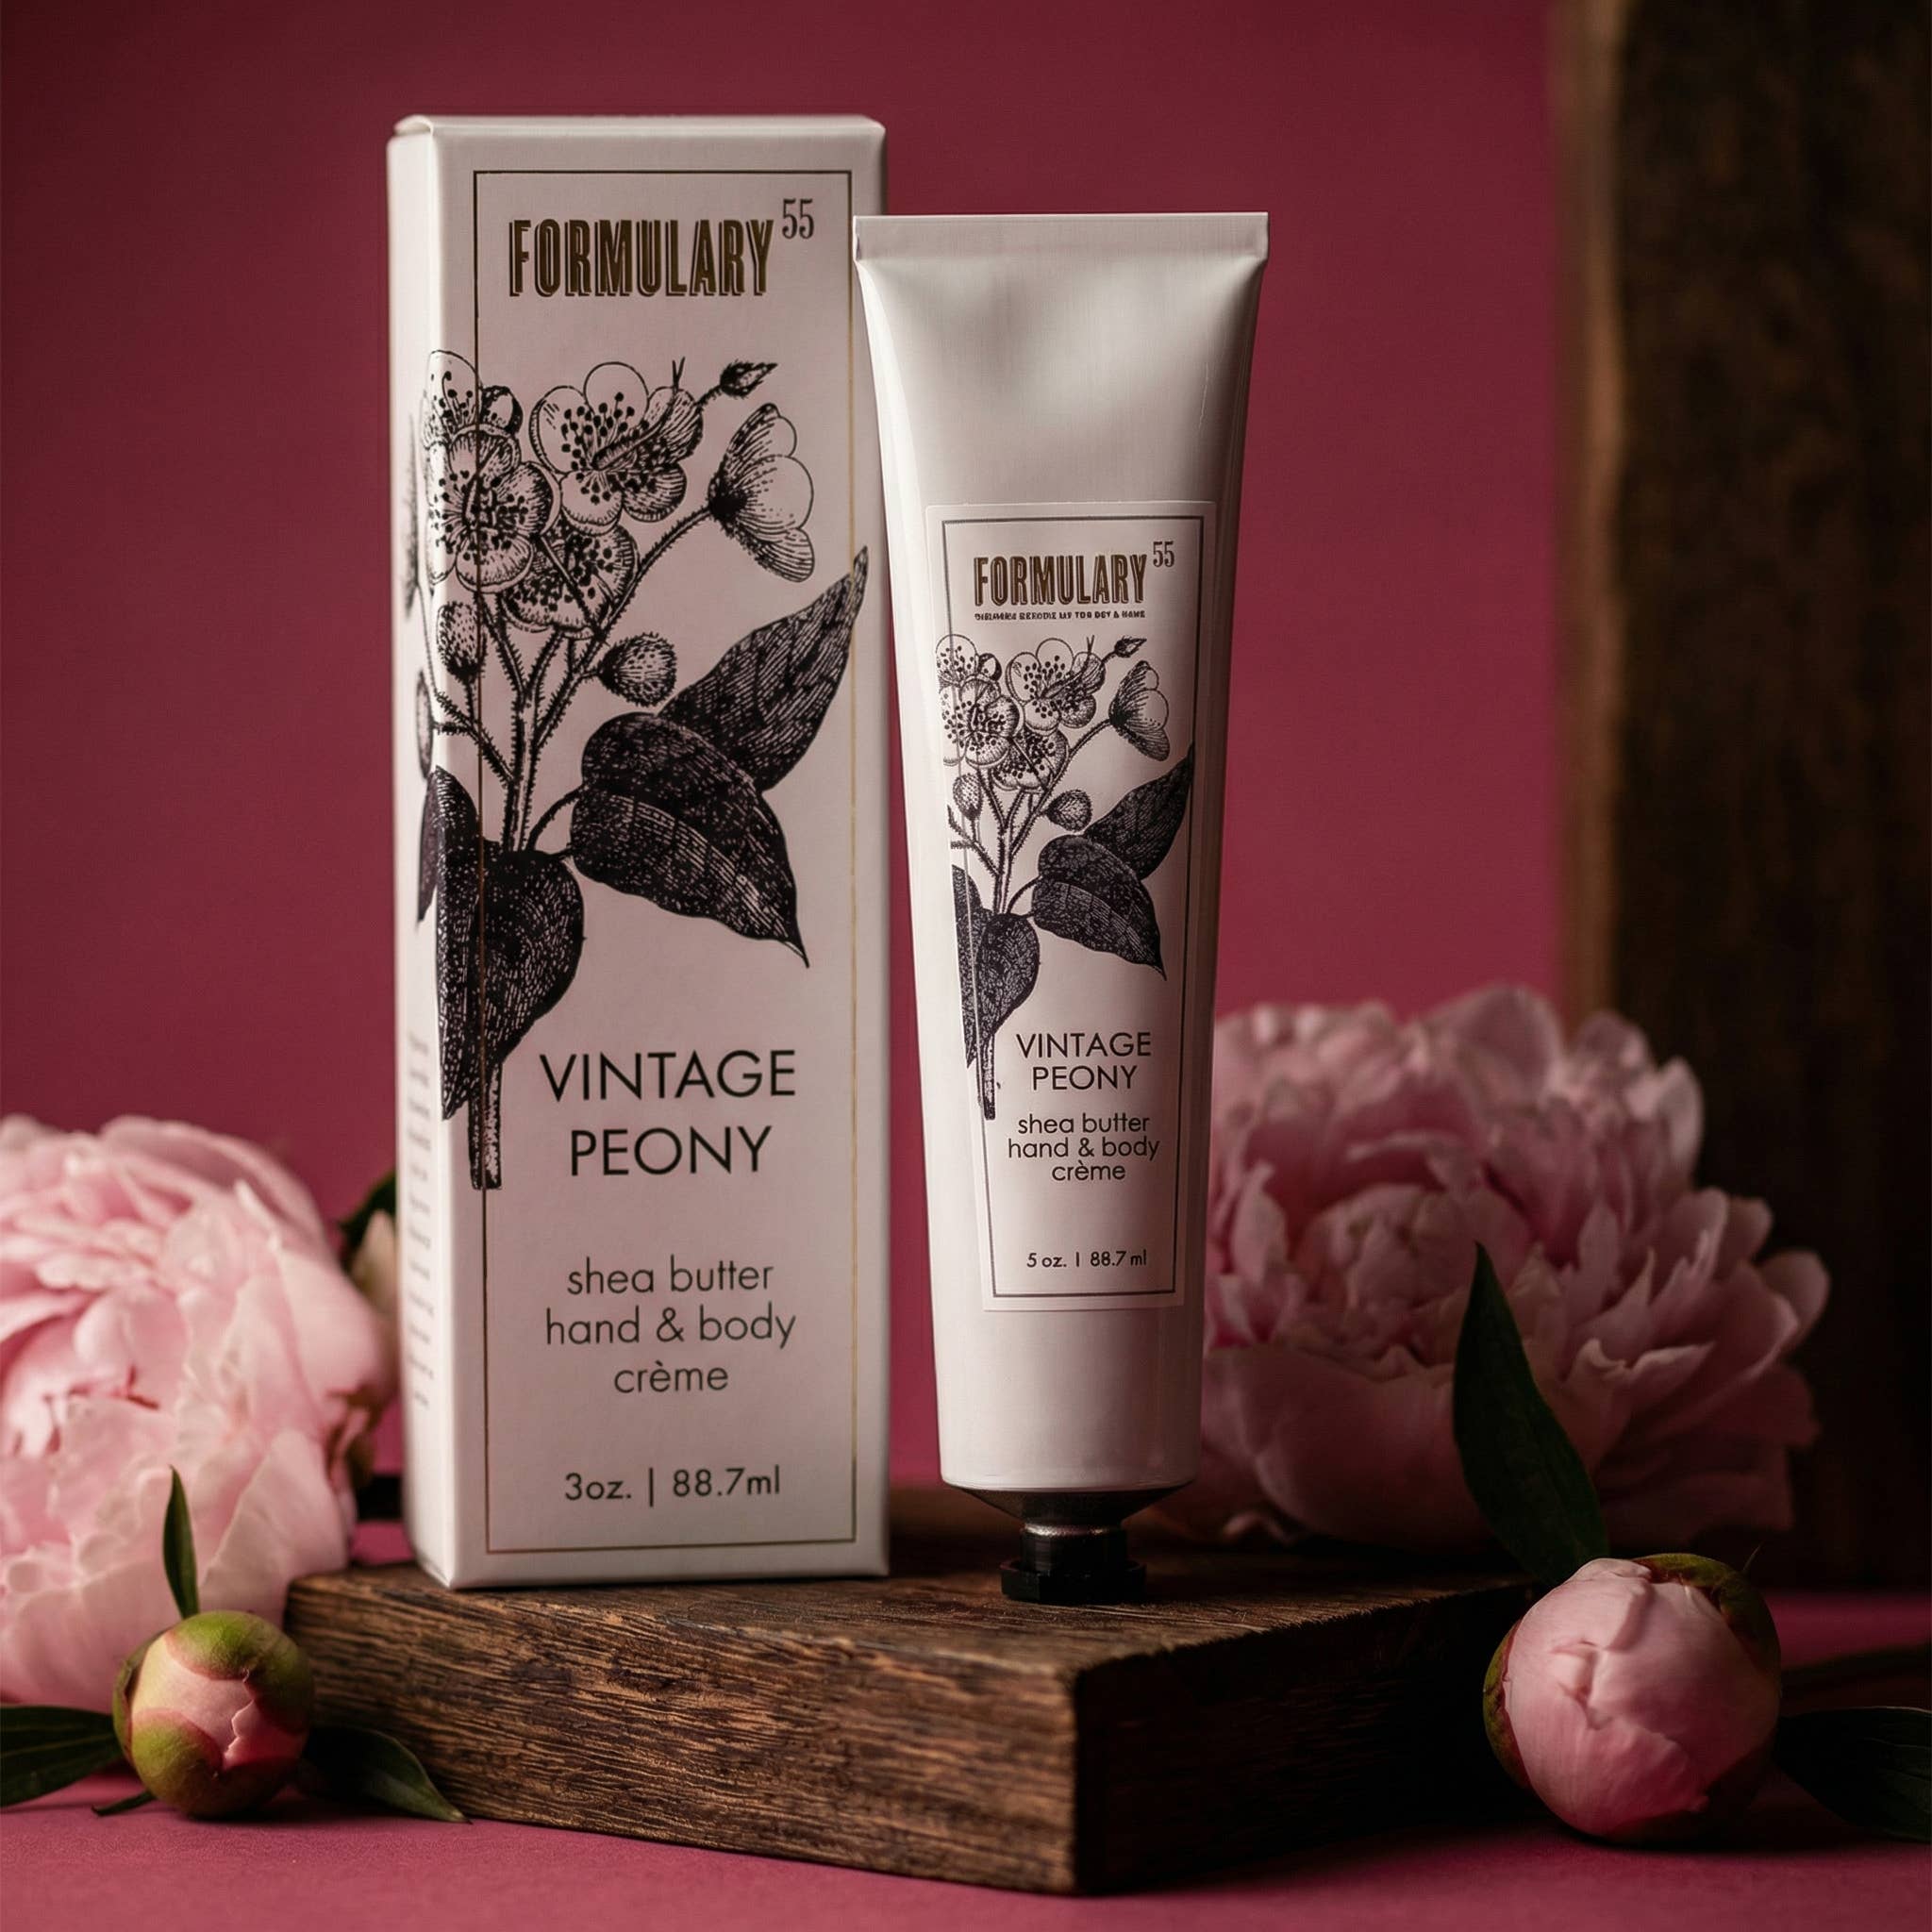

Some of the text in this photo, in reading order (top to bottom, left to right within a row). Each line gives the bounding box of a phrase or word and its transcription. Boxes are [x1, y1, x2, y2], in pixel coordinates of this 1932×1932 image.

[508, 197, 815, 297] FORMULARY 55
[974, 541, 1175, 607] FORMULARY 55
[1015, 1031, 1152, 1058] VINTAGE
[539, 1049, 796, 1102] VINTAGE
[1032, 1064, 1138, 1091] PEONY
[1017, 1112, 1150, 1135] shea butter
[571, 1125, 772, 1177] PEONY
[1008, 1136, 1160, 1161] hand & body
[1051, 1159, 1126, 1182] crème
[567, 1254, 774, 1295] shea butter
[1025, 1252, 1038, 1269] 5
[1041, 1256, 1068, 1269] oz.
[1090, 1250, 1127, 1268] 88.7
[1130, 1249, 1147, 1267] ml
[546, 1302, 797, 1350] hand & body
[613, 1359, 729, 1394] crème
[564, 1472, 632, 1502] 3oz.
[672, 1464, 780, 1498] 88.7ml
